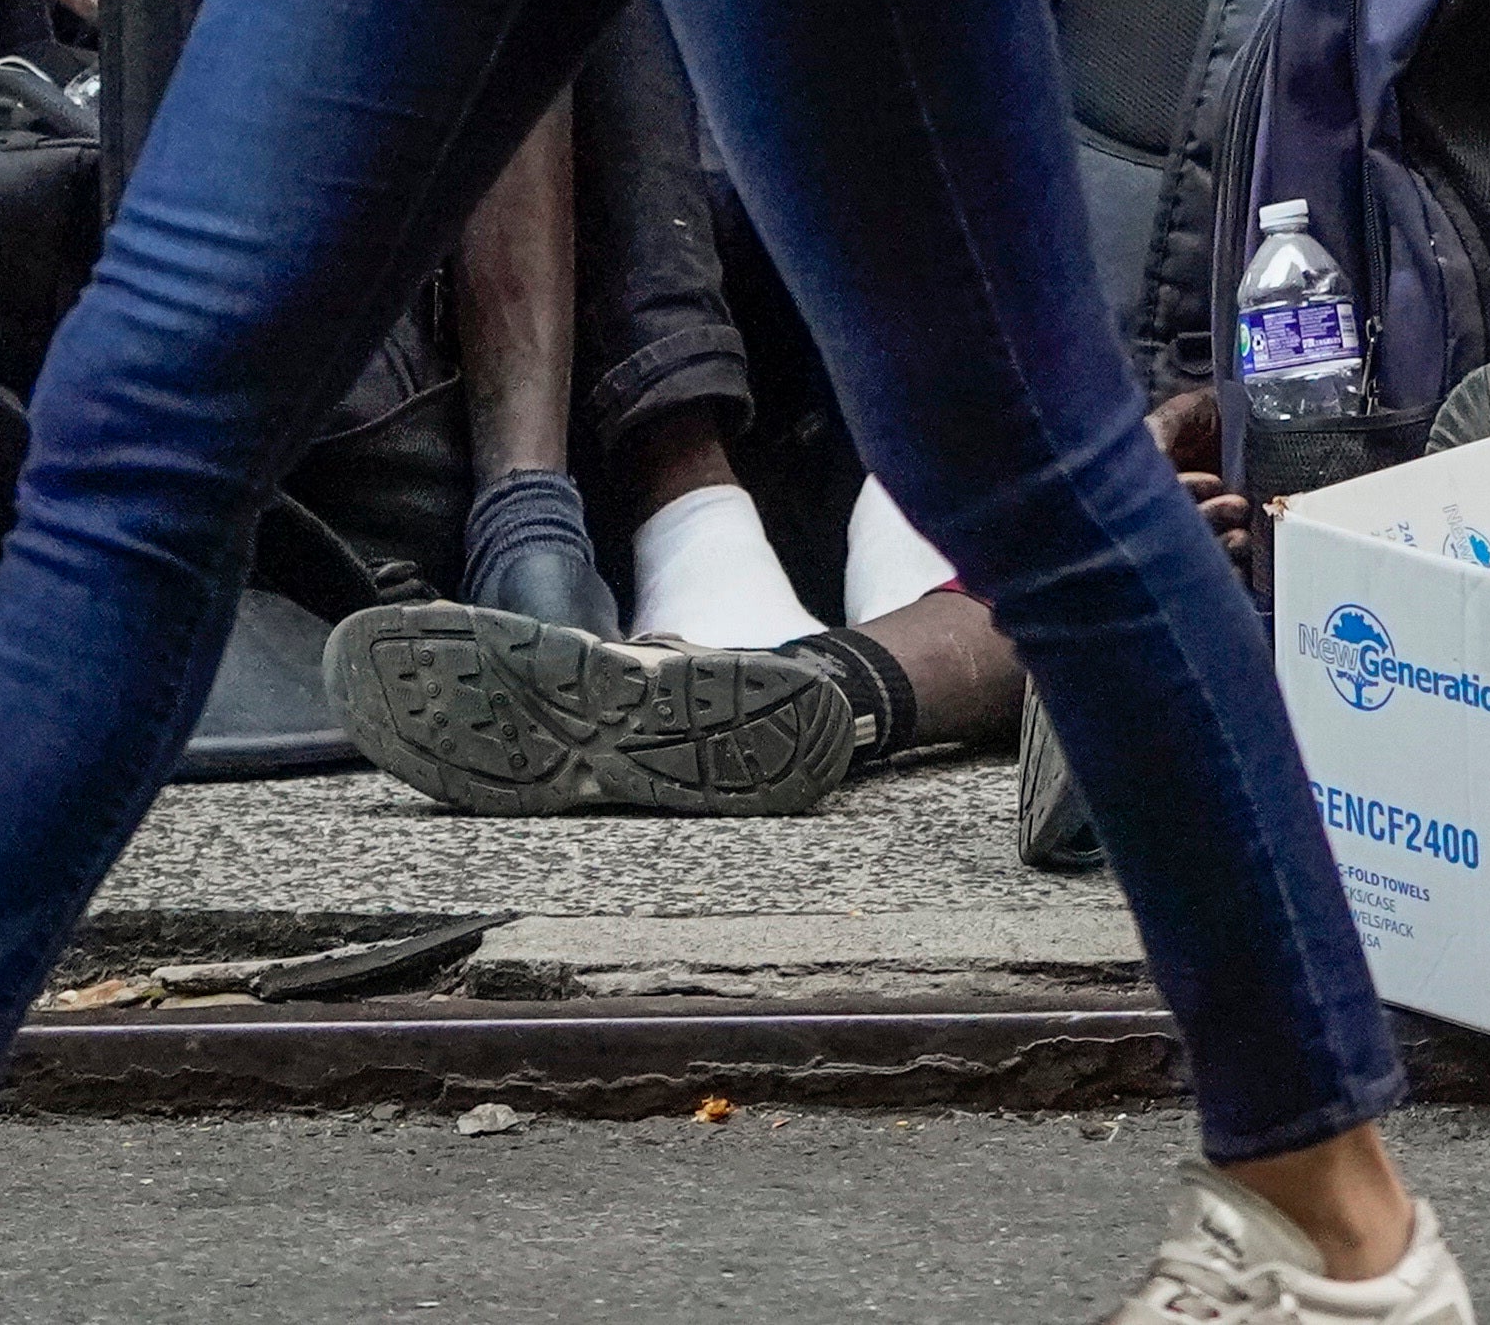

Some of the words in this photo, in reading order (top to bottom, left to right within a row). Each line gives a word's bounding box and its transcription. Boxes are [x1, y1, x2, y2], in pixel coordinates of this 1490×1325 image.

[1308, 780, 1479, 870] GENCF2400
[1344, 885, 1396, 913] CKS/CASE
[1382, 876, 1430, 902] TOWELS
[1350, 909, 1414, 939] WELS/PACK
